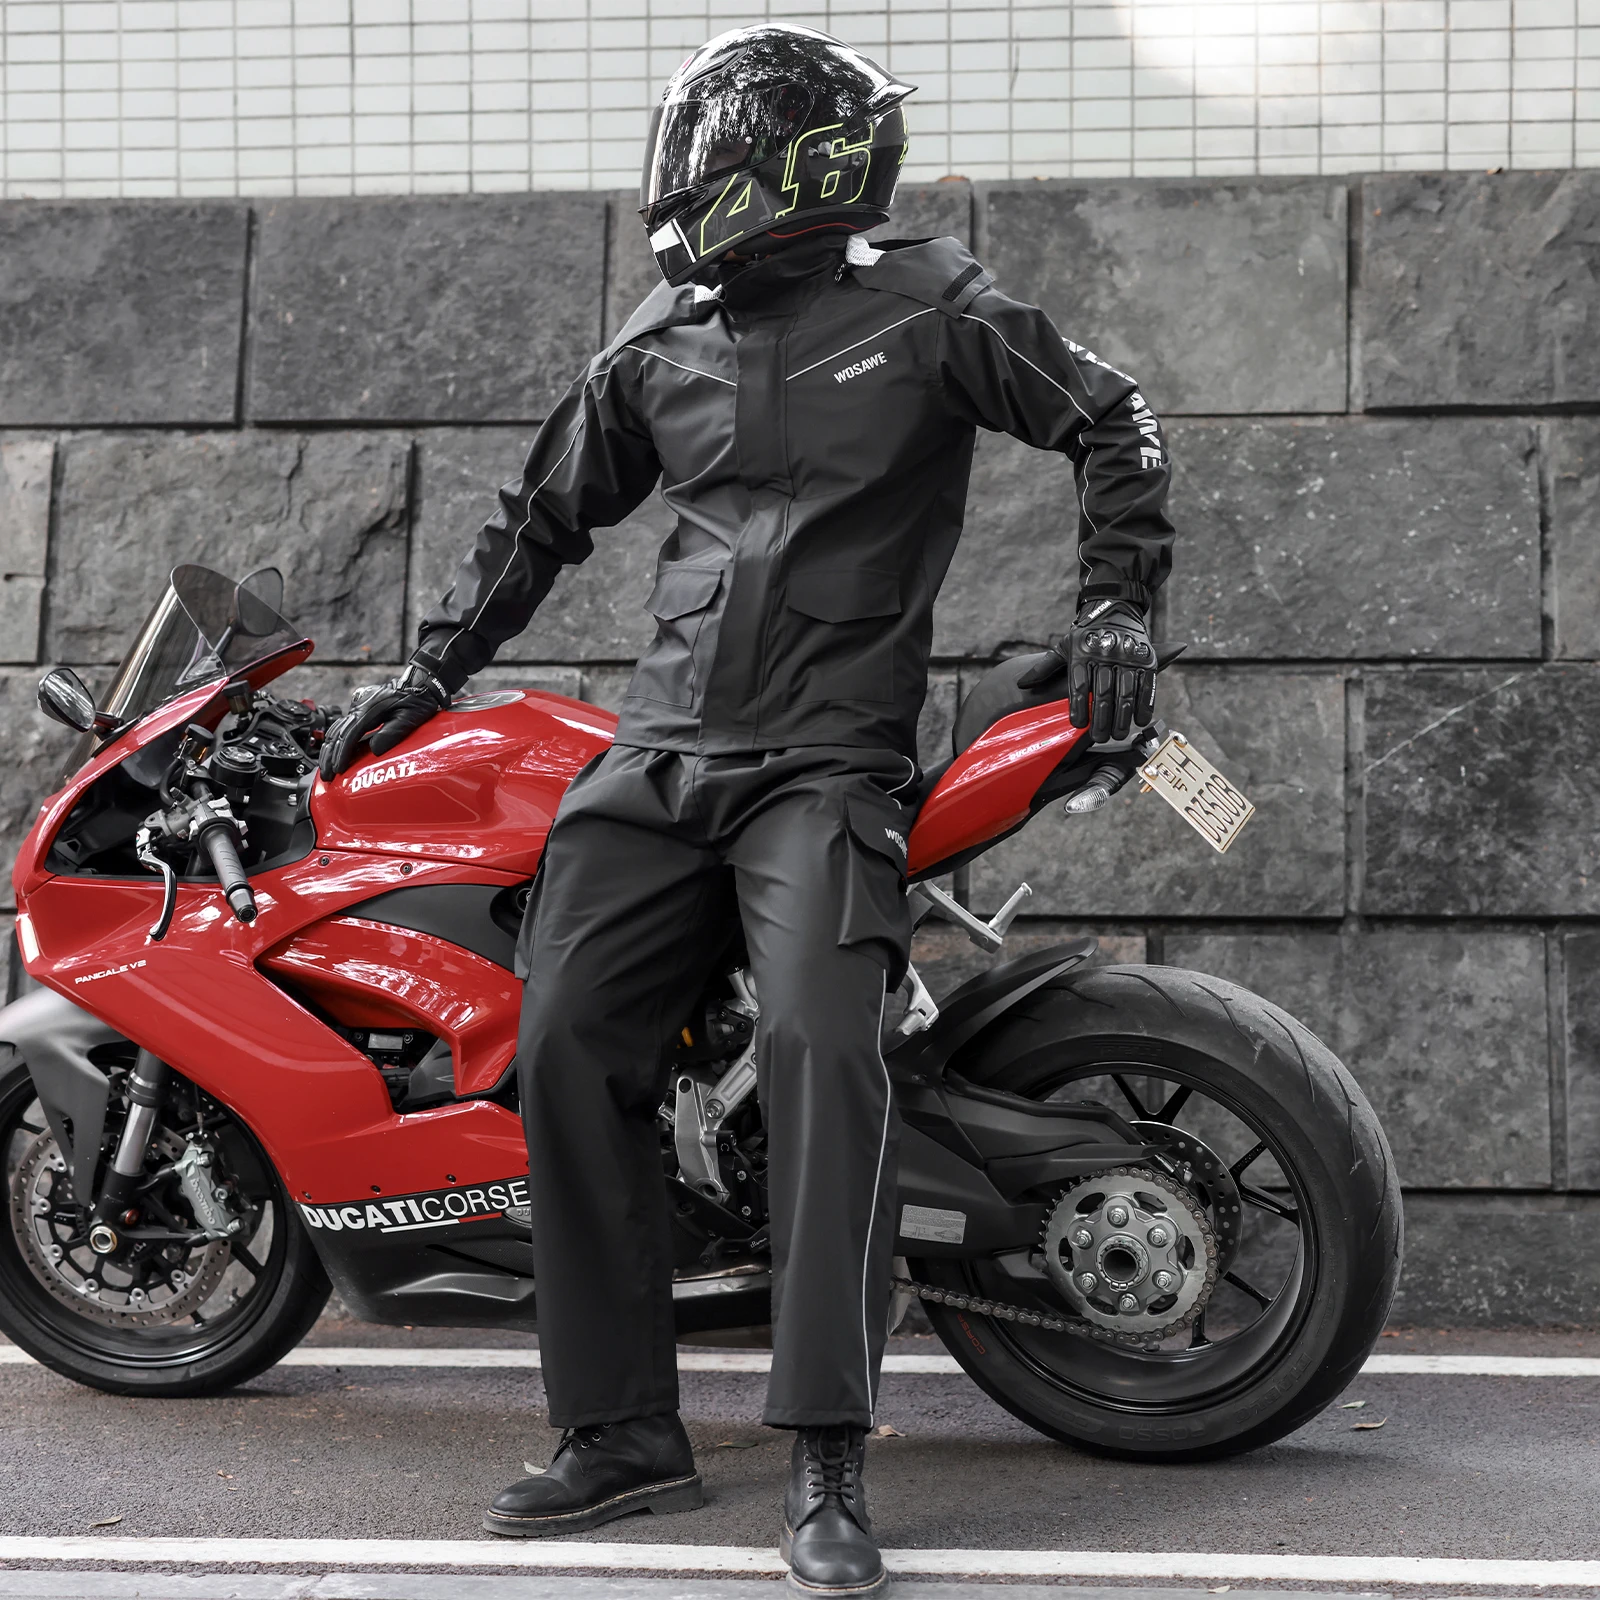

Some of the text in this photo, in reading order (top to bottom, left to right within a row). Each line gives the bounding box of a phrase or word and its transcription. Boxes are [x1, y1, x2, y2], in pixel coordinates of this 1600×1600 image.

[833, 351, 888, 384] WOSAWE
[350, 761, 417, 793] DUCATI
[74, 959, 147, 985] PANIGALE V2
[191, 1177, 216, 1225] brembo
[956, 1313, 986, 1355] CORSA
